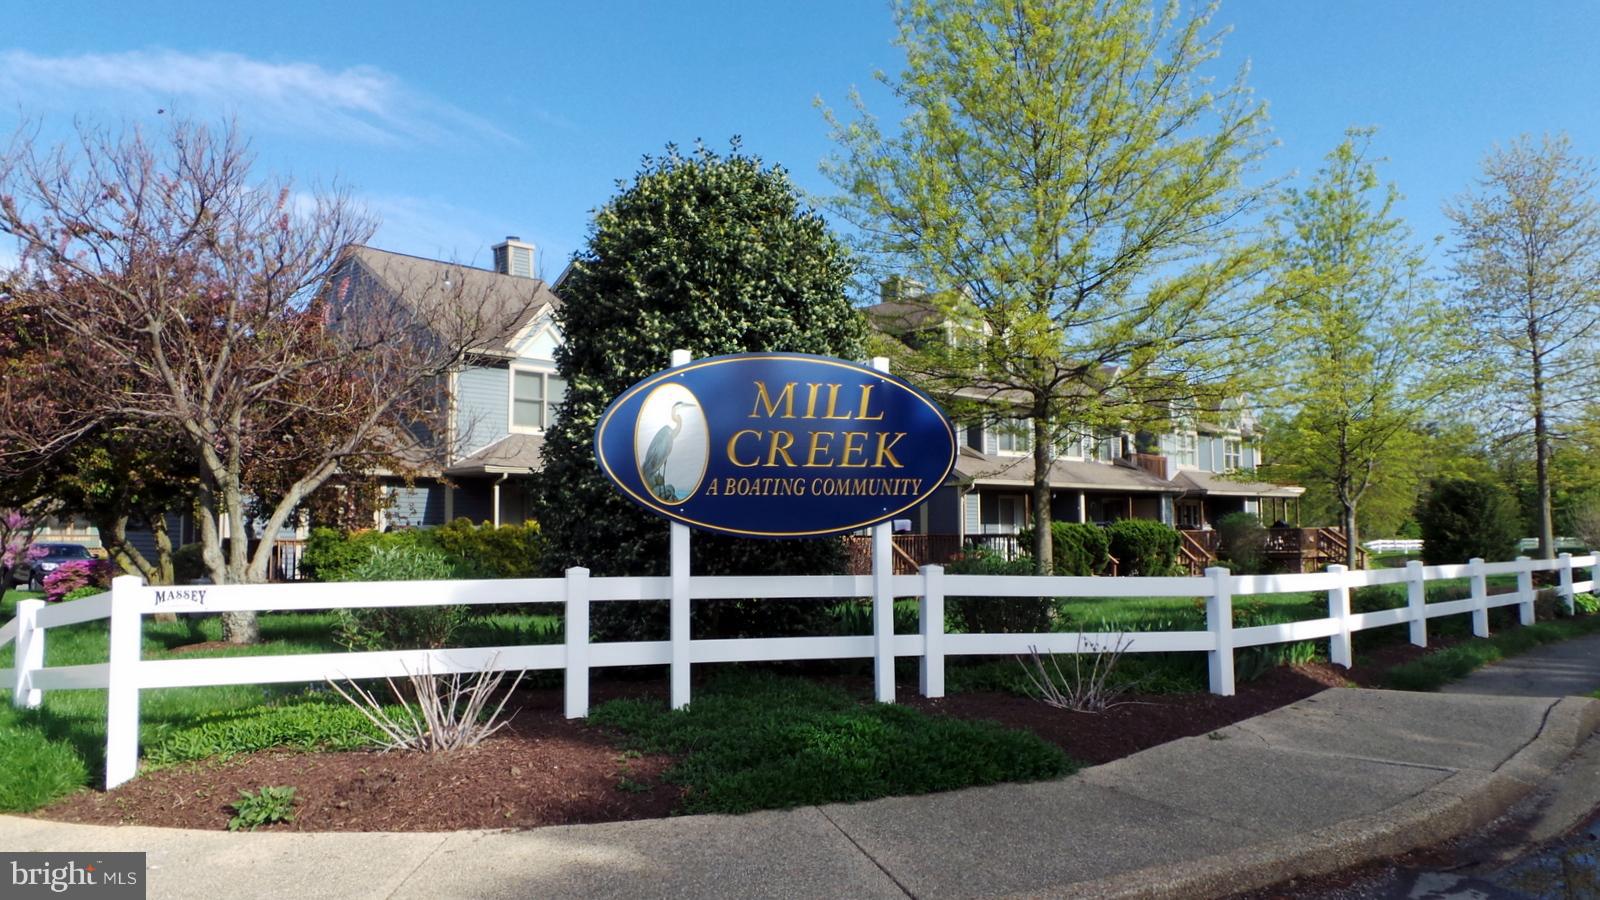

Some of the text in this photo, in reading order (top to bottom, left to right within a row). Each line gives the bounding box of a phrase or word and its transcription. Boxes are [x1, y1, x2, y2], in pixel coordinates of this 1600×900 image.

[749, 381, 884, 420] MILL
[727, 429, 907, 467] CREEK
[706, 477, 923, 496] A BOATING COMMUNITY
[154, 589, 207, 606] MASSEY
